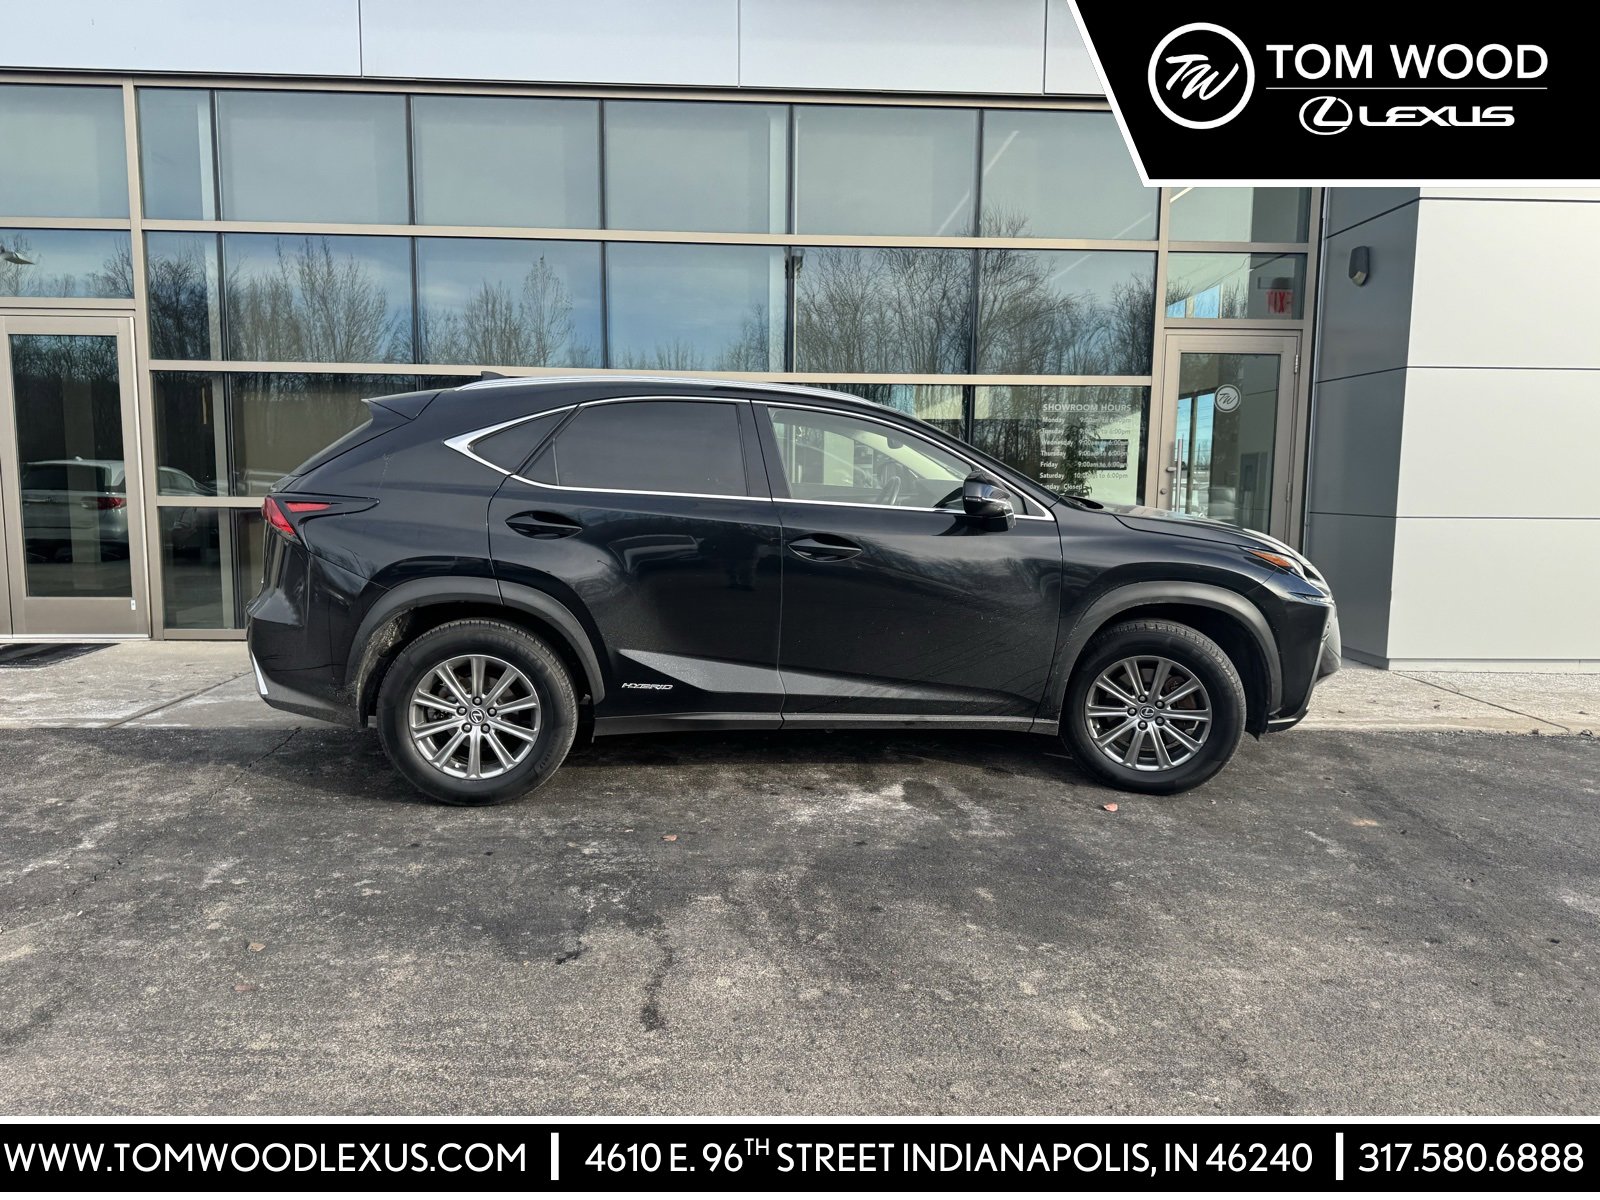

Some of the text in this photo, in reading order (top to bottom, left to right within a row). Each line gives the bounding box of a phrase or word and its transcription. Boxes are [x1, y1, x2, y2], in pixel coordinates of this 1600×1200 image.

[1042, 403, 1098, 411] SHOWROOM
[1041, 450, 1066, 458] Thursday
[1039, 472, 1065, 480] Saturday
[621, 682, 674, 690] HYBRID
